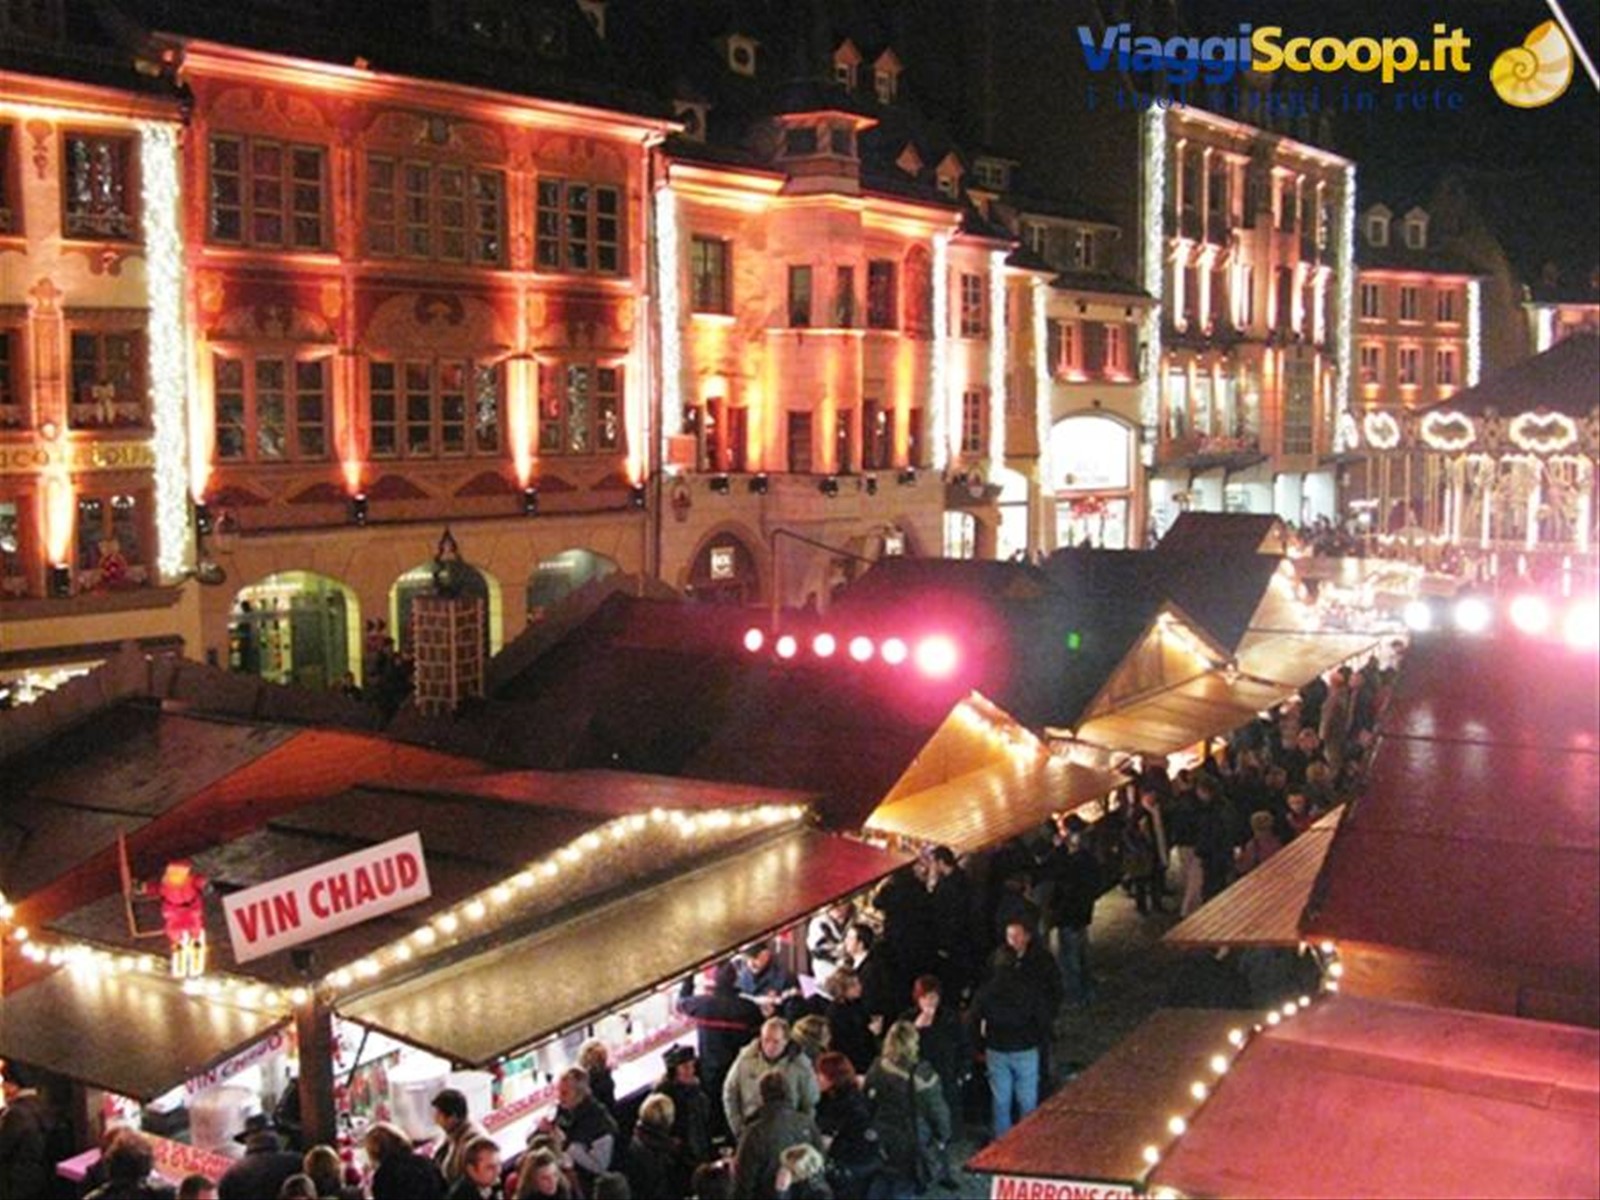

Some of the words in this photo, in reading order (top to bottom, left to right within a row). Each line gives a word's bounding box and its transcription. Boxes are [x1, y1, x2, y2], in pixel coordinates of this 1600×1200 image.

[234, 891, 300, 944] VIN
[308, 851, 419, 919] CHAUD
[184, 1069, 218, 1095] VIN
